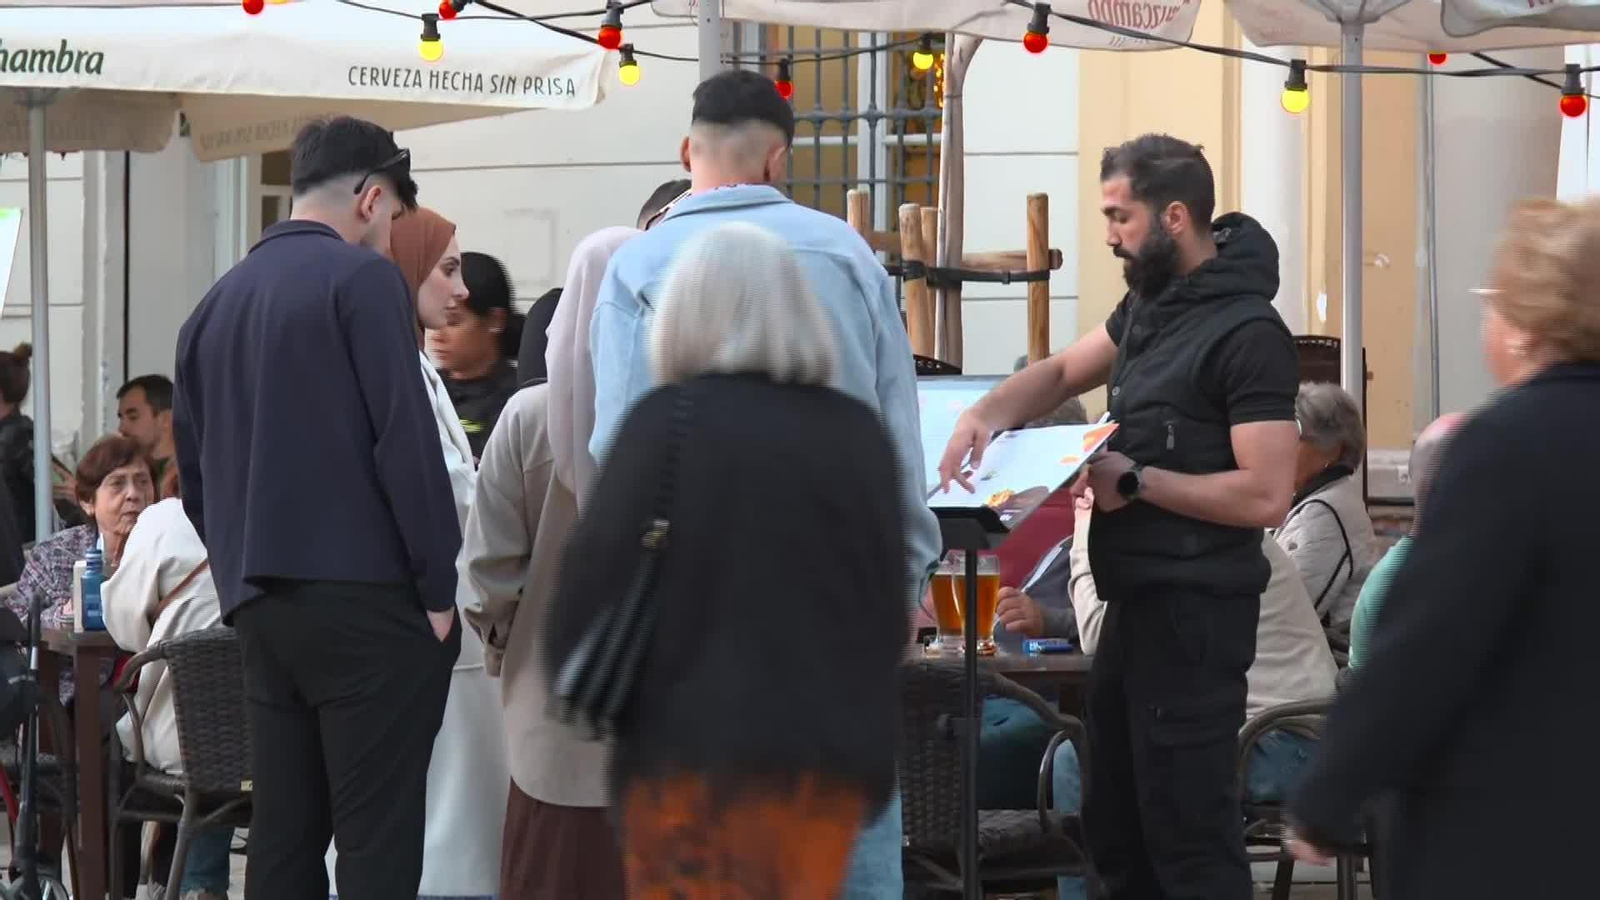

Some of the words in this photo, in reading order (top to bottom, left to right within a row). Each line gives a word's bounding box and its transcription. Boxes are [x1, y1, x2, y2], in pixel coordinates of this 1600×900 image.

[348, 66, 422, 89] CERVEZA
[429, 70, 483, 93] HECHA
[490, 74, 516, 95] SIN
[523, 76, 575, 97] PRISA
